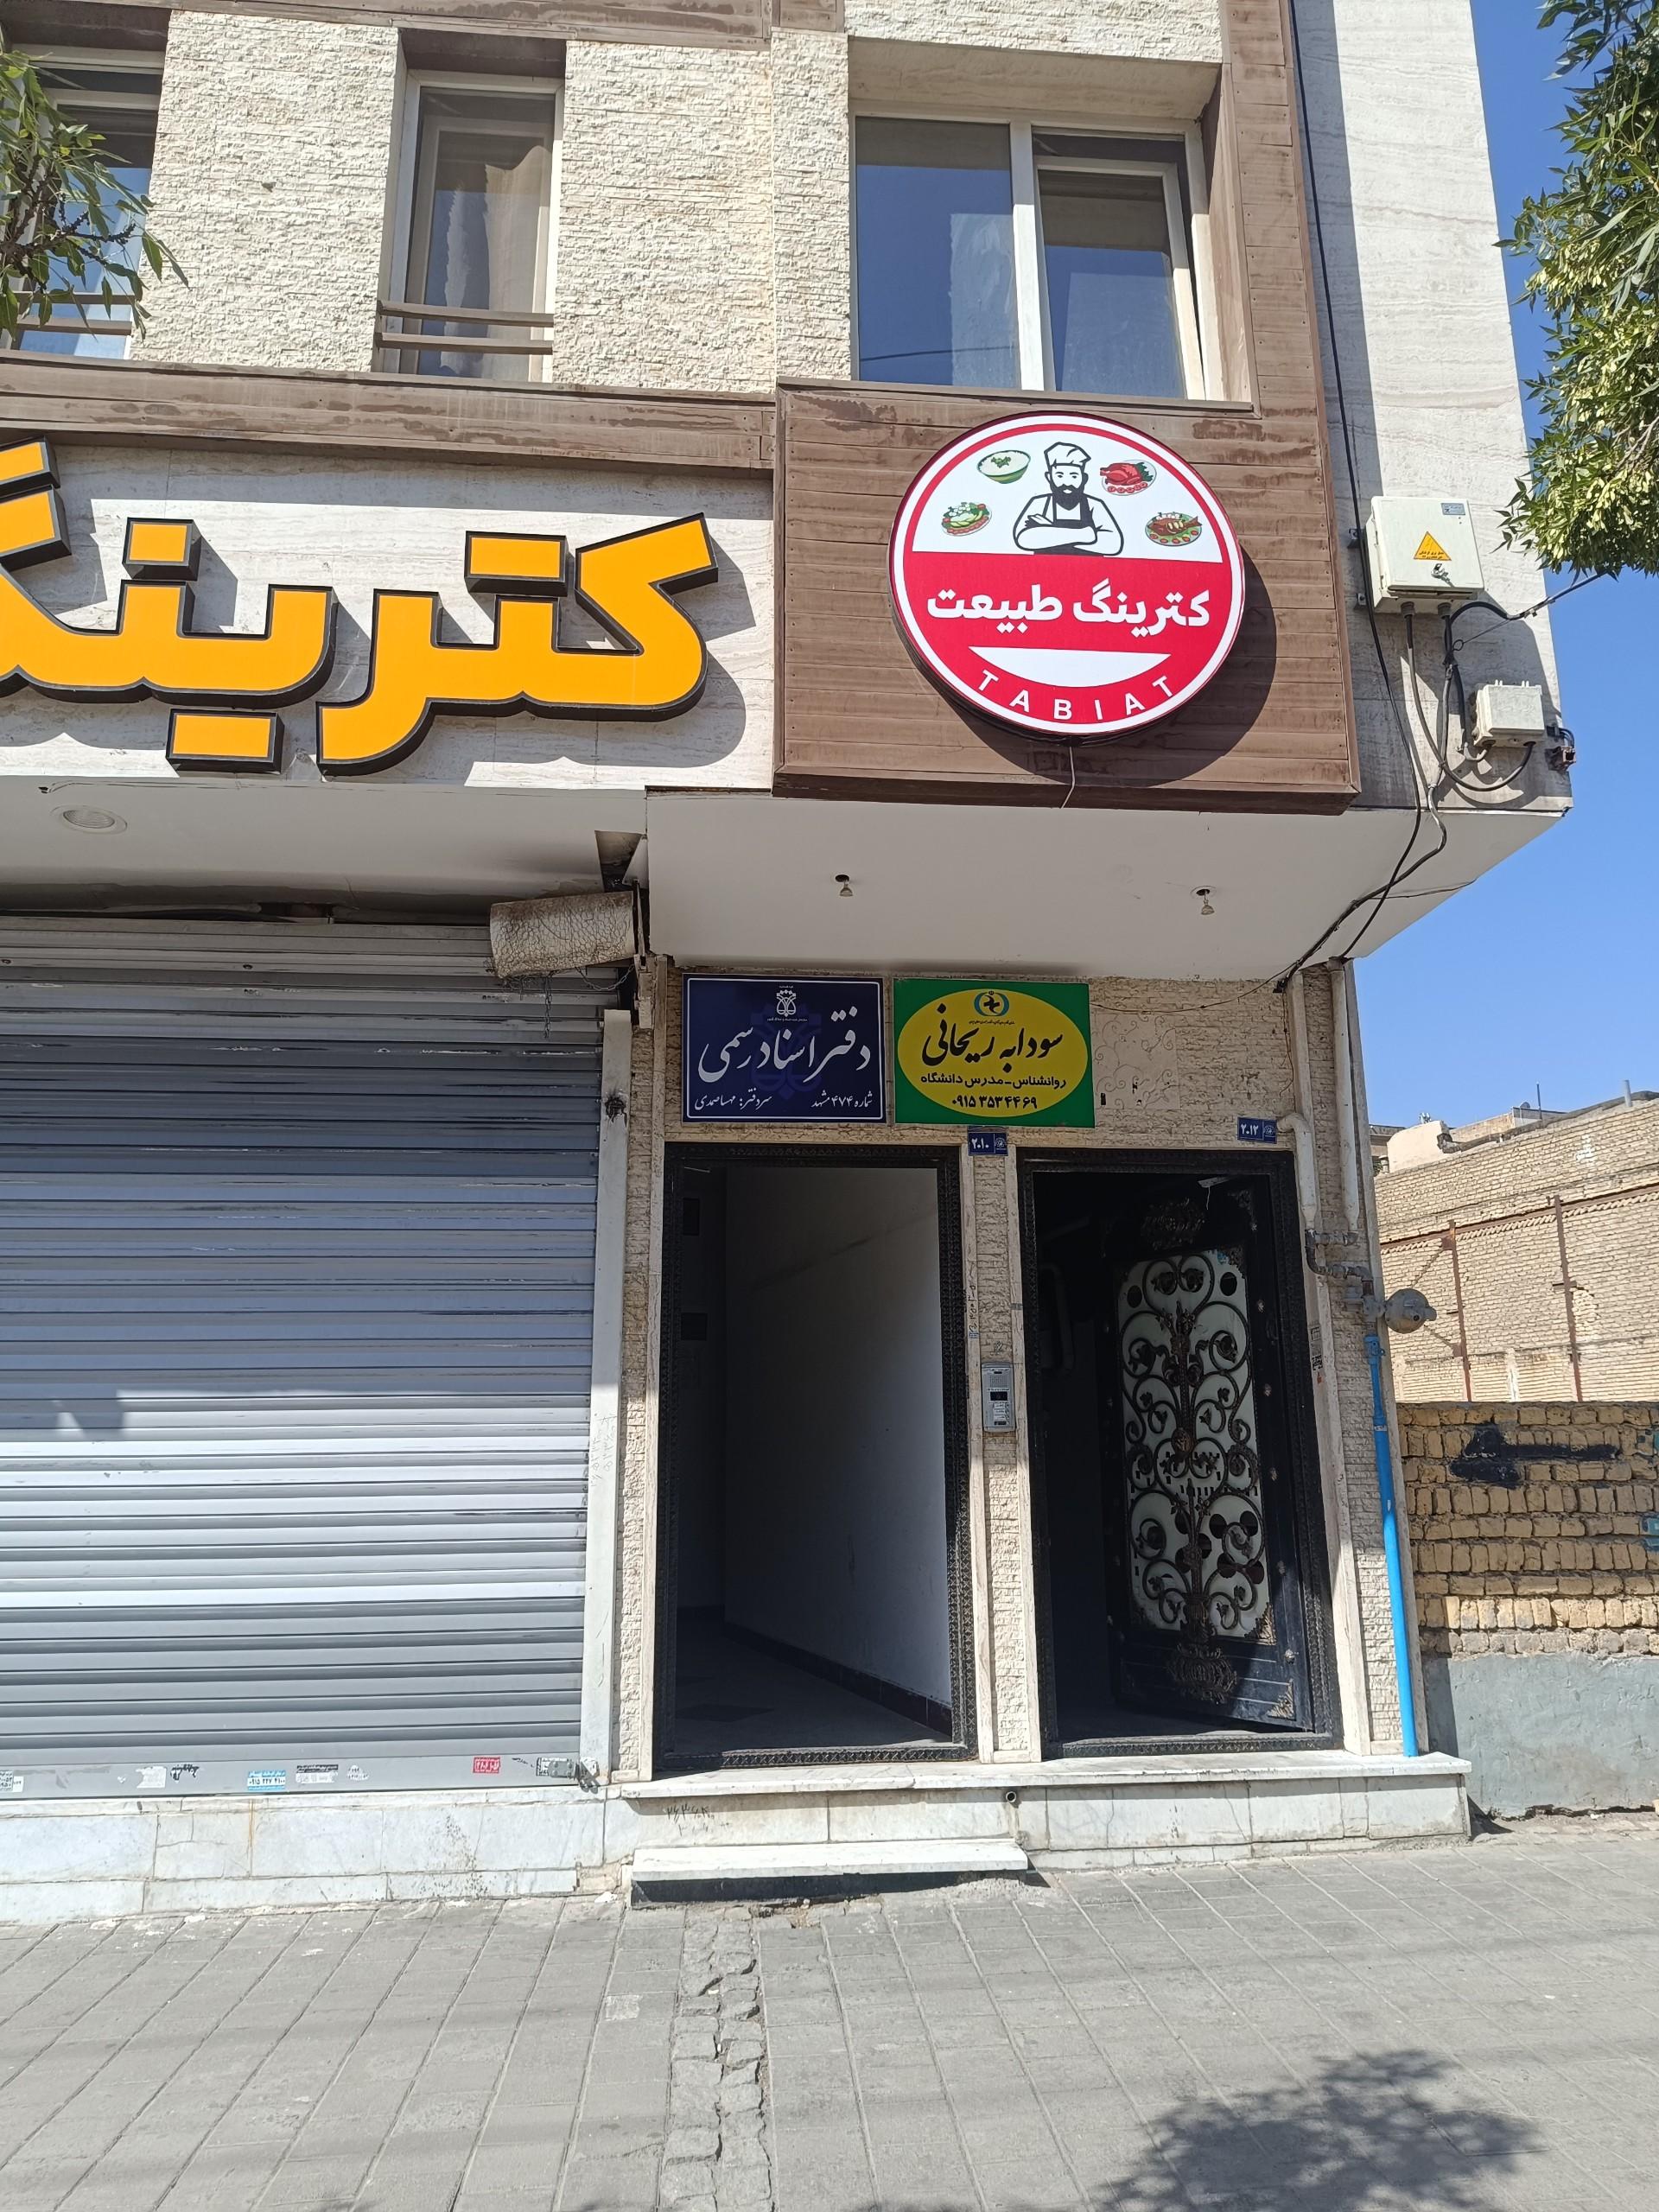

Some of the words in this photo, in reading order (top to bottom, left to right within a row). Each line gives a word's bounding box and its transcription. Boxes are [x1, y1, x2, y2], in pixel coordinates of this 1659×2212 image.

[927, 583, 1064, 634] طبیعت
[1073, 577, 1211, 637] کترینگ
[977, 669, 1174, 721] TABIAT
[697, 1027, 754, 1084] رسمی
[756, 1028, 816, 1070] اسناد
[803, 1006, 871, 1083] دفتر
[921, 1002, 995, 1067] ریحانی
[999, 1027, 1065, 1073] سودابه
[810, 1089, 830, 1108] مشهد
[854, 1090, 873, 1108] شماره
[920, 1071, 963, 1084] دانشگاه
[831, 1095, 854, 1107] ۴۷۴
[971, 1137, 989, 1149] ۲۰۱۰
[1240, 1123, 1259, 1136] ۲۰۱۲
